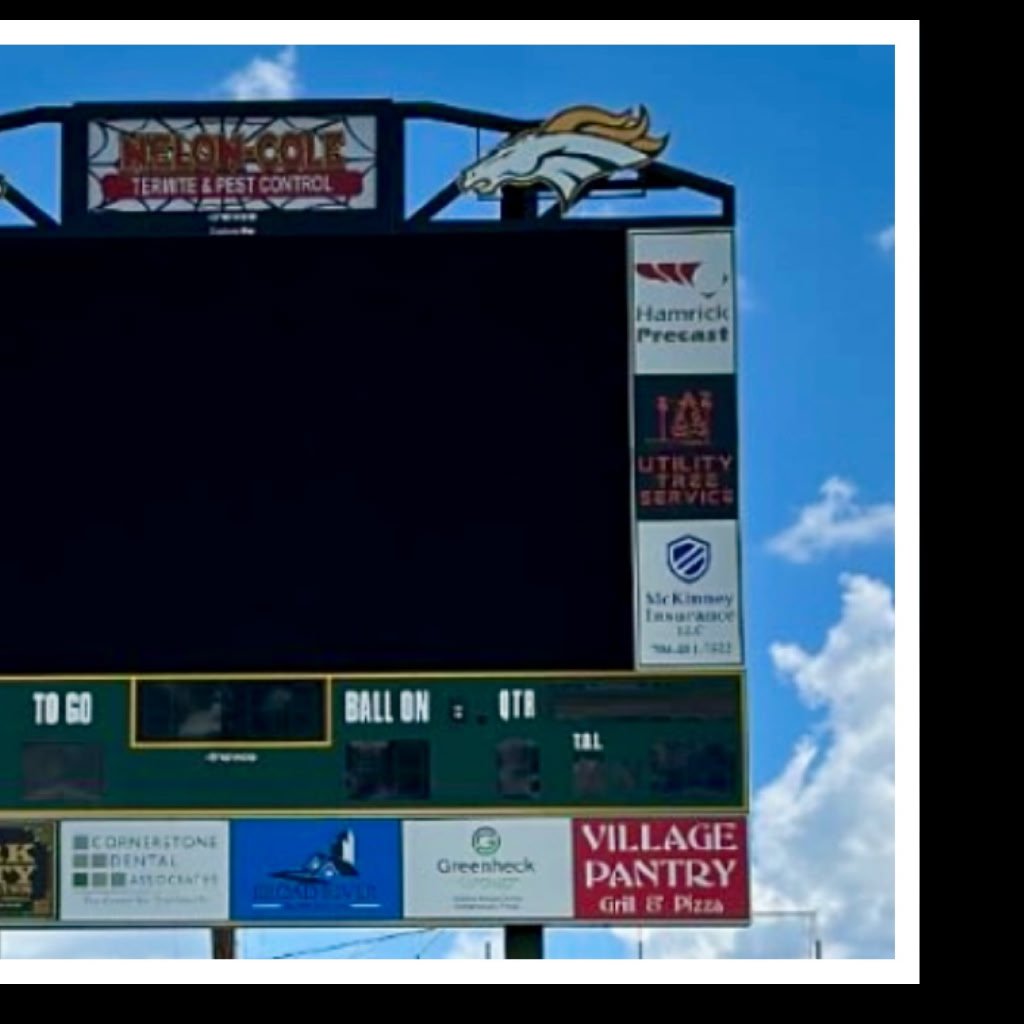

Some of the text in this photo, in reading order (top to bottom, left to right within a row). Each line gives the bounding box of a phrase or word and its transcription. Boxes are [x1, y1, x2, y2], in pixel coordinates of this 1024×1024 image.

[132, 174, 334, 195] TERMITE & PEST CONTROL
[637, 304, 729, 322] Hamrick
[637, 327, 729, 343] Precast
[638, 455, 733, 473] UTILITY
[639, 490, 734, 506] SERVICE
[33, 692, 92, 725] TO GO
[344, 690, 430, 723] BALL ON
[499, 689, 536, 720] QTR
[91, 835, 218, 849] CORNERSTONE
[580, 823, 739, 851] VILLAGE
[110, 853, 176, 867] DENTAL
[437, 858, 536, 874] Greenheck
[585, 858, 738, 889] PANTRY
[599, 894, 637, 914] Grill
[674, 894, 724, 914] Pizza
